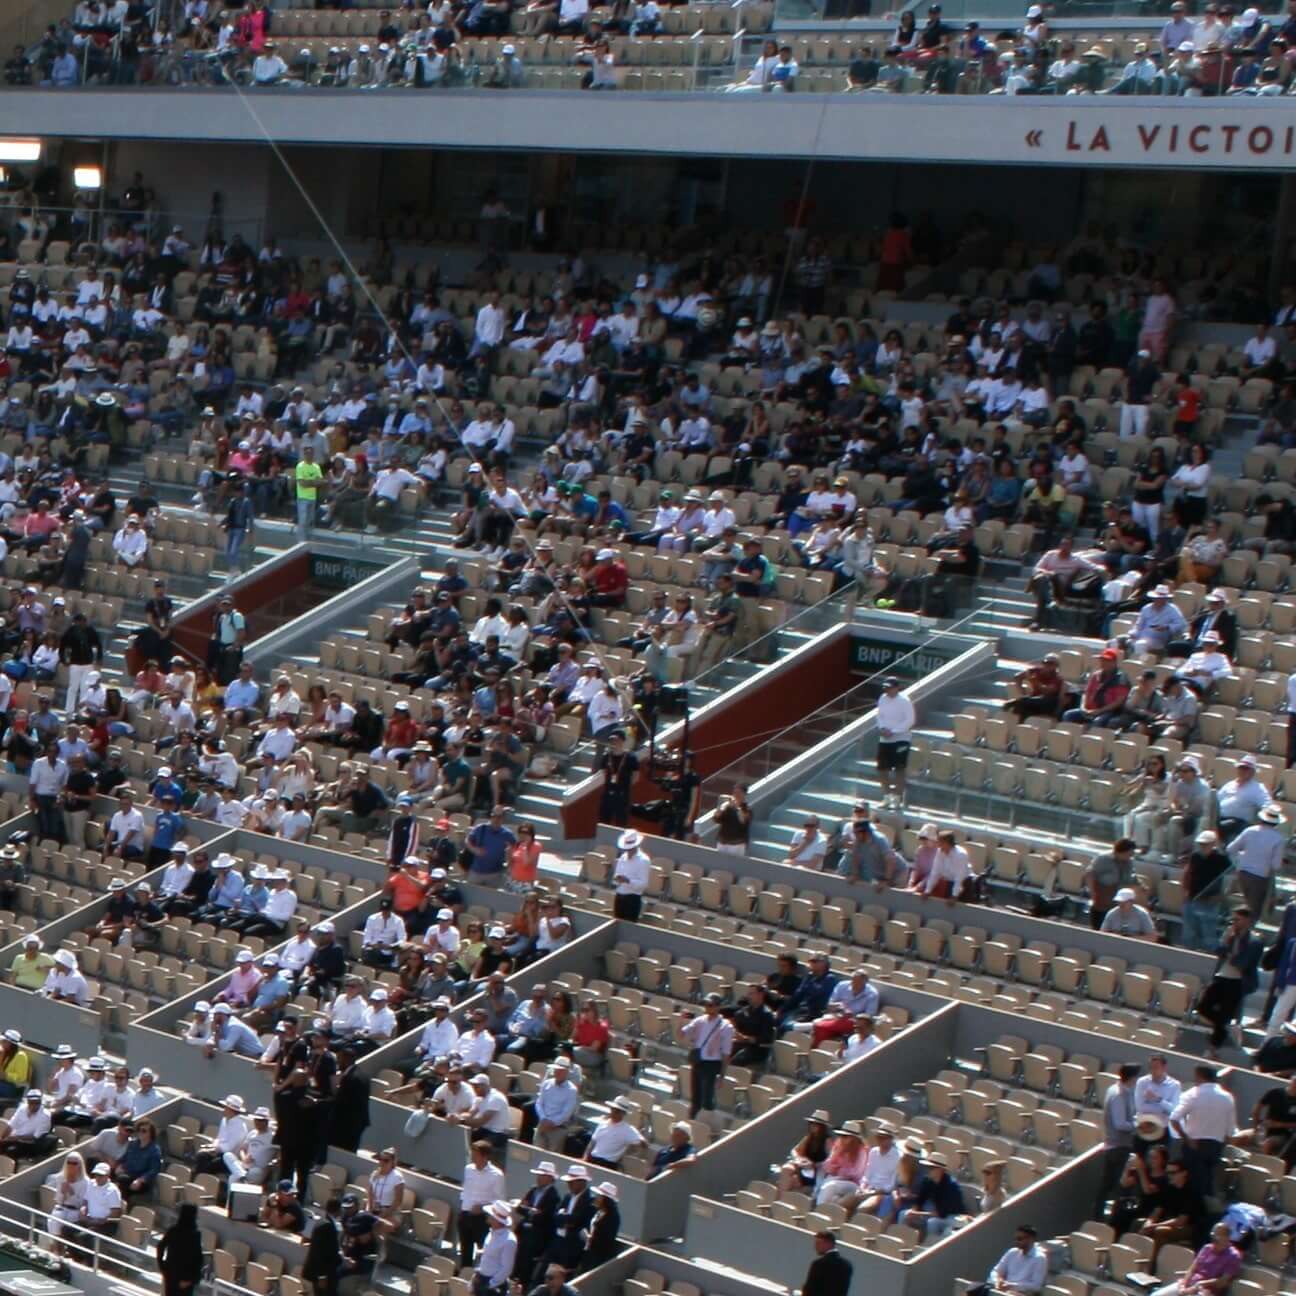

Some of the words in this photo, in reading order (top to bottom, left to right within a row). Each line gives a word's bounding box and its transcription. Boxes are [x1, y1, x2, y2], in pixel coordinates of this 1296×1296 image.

[1066, 121, 1111, 151] LA
[1138, 124, 1295, 154] VICTOI
[315, 560, 342, 577] BNP
[858, 645, 891, 664] BNP
